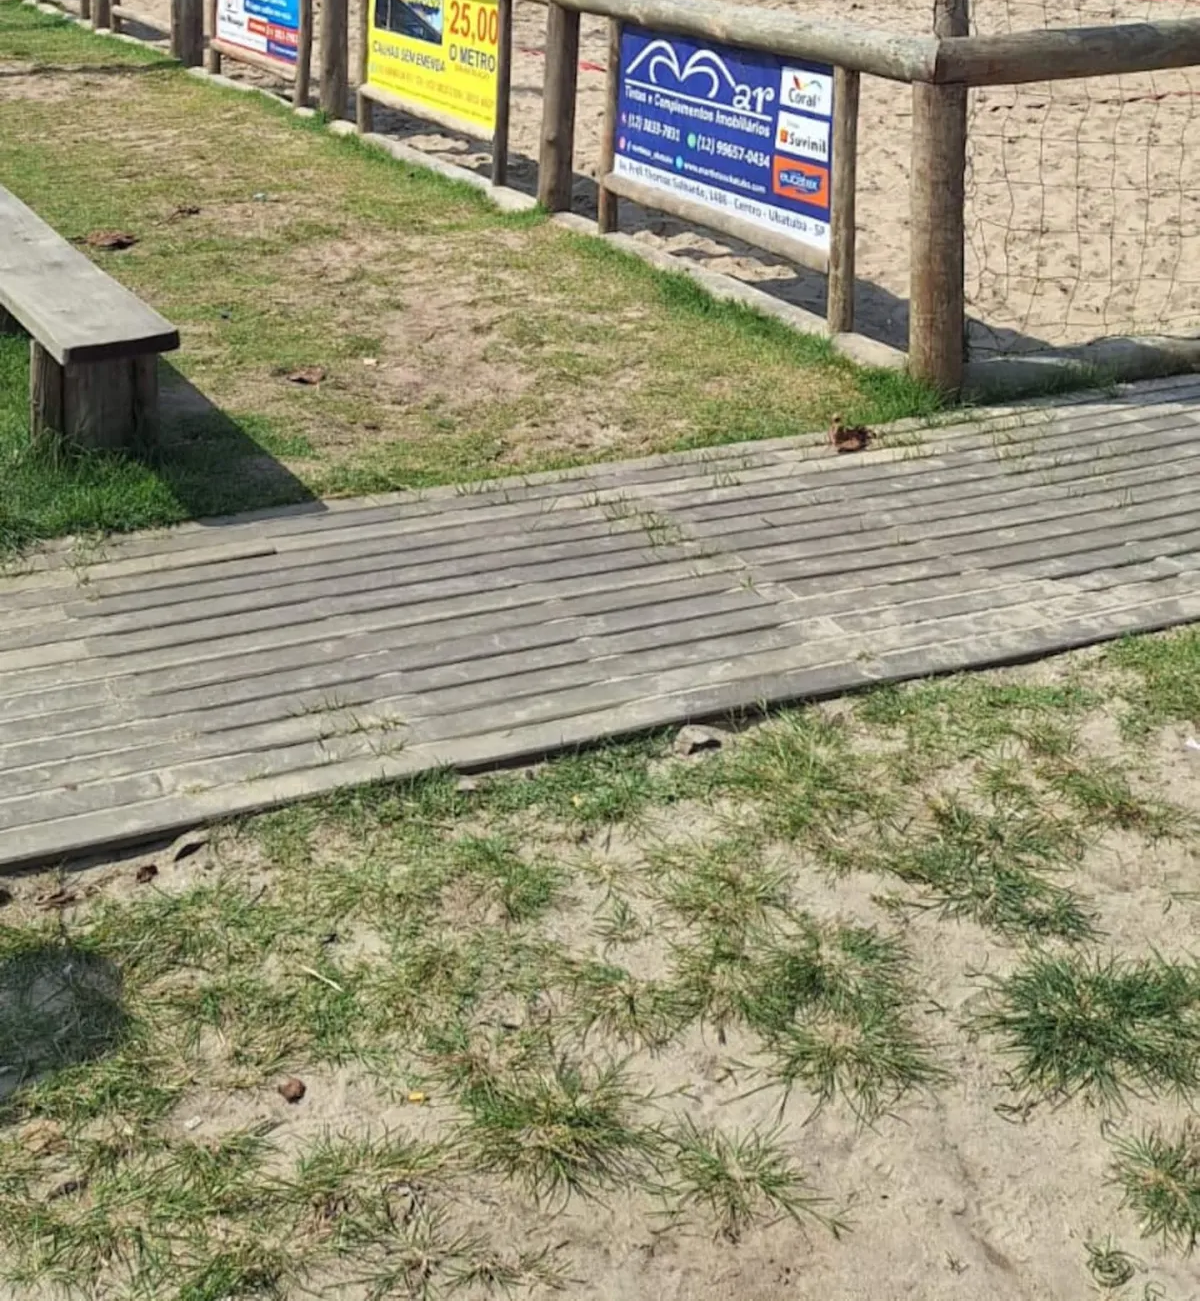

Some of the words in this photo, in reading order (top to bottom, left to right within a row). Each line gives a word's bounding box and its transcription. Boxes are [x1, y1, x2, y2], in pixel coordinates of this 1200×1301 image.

[449, 0, 498, 45] 25,00
[400, 47, 415, 65] SEM
[449, 43, 458, 62] O
[459, 46, 496, 73] METRO
[625, 85, 647, 103] Tintas
[654, 93, 714, 122] Complementos
[788, 86, 817, 108] Coral
[697, 133, 715, 155] (12)
[789, 131, 828, 154] Suvinil
[734, 197, 762, 218] Centro
[768, 209, 807, 232] Ubatuba
[814, 224, 825, 236] SP
